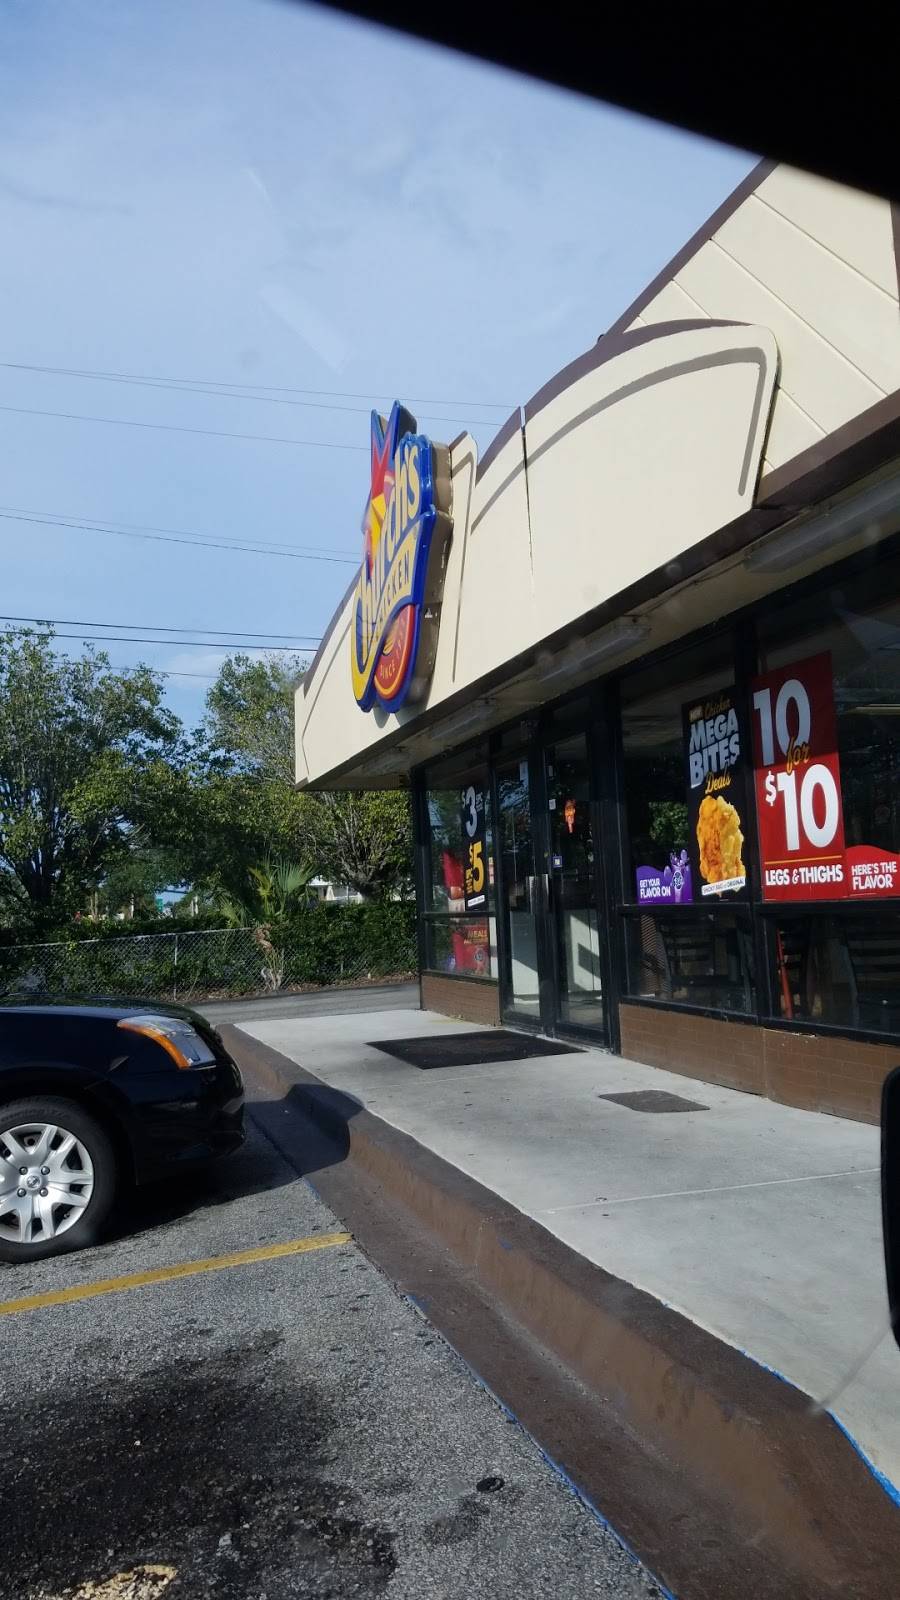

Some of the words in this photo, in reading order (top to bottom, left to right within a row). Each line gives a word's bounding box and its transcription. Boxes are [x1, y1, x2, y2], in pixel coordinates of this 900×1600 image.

[690, 708, 738, 753] MEGA
[753, 679, 811, 766] 10
[689, 733, 740, 789] BITES
[786, 735, 810, 776] for
[705, 763, 732, 794] Deals
[765, 764, 839, 851] $10
[640, 879, 648, 888] GET
[648, 878, 660, 887] YOUR
[765, 869, 789, 886] LEGS
[792, 868, 799, 885] &
[799, 864, 844, 884] THIGHS
[851, 862, 879, 876] HERE'S
[880, 861, 898, 874] THE
[853, 874, 893, 890] FLAVOR
[640, 886, 661, 899] FLAVOR
[661, 886, 671, 897] ON
